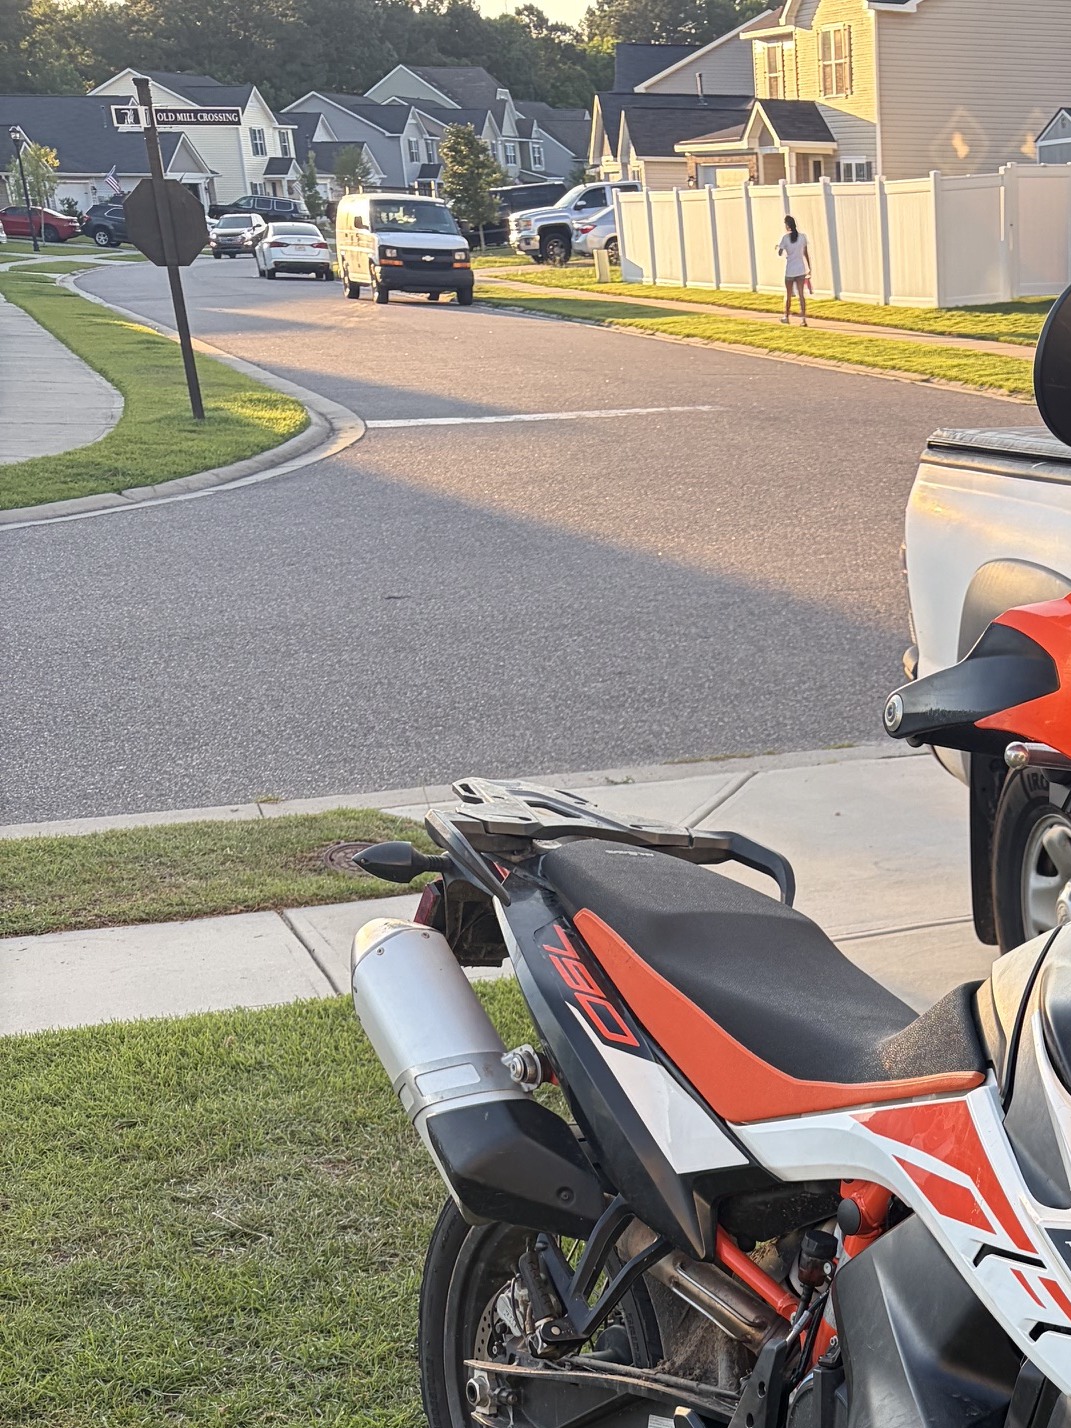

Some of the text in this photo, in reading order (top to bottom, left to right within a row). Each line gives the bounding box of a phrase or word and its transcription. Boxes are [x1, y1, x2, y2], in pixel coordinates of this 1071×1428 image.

[157, 112, 239, 122] OLD MILL CROSSING
[542, 924, 640, 1047] 790
